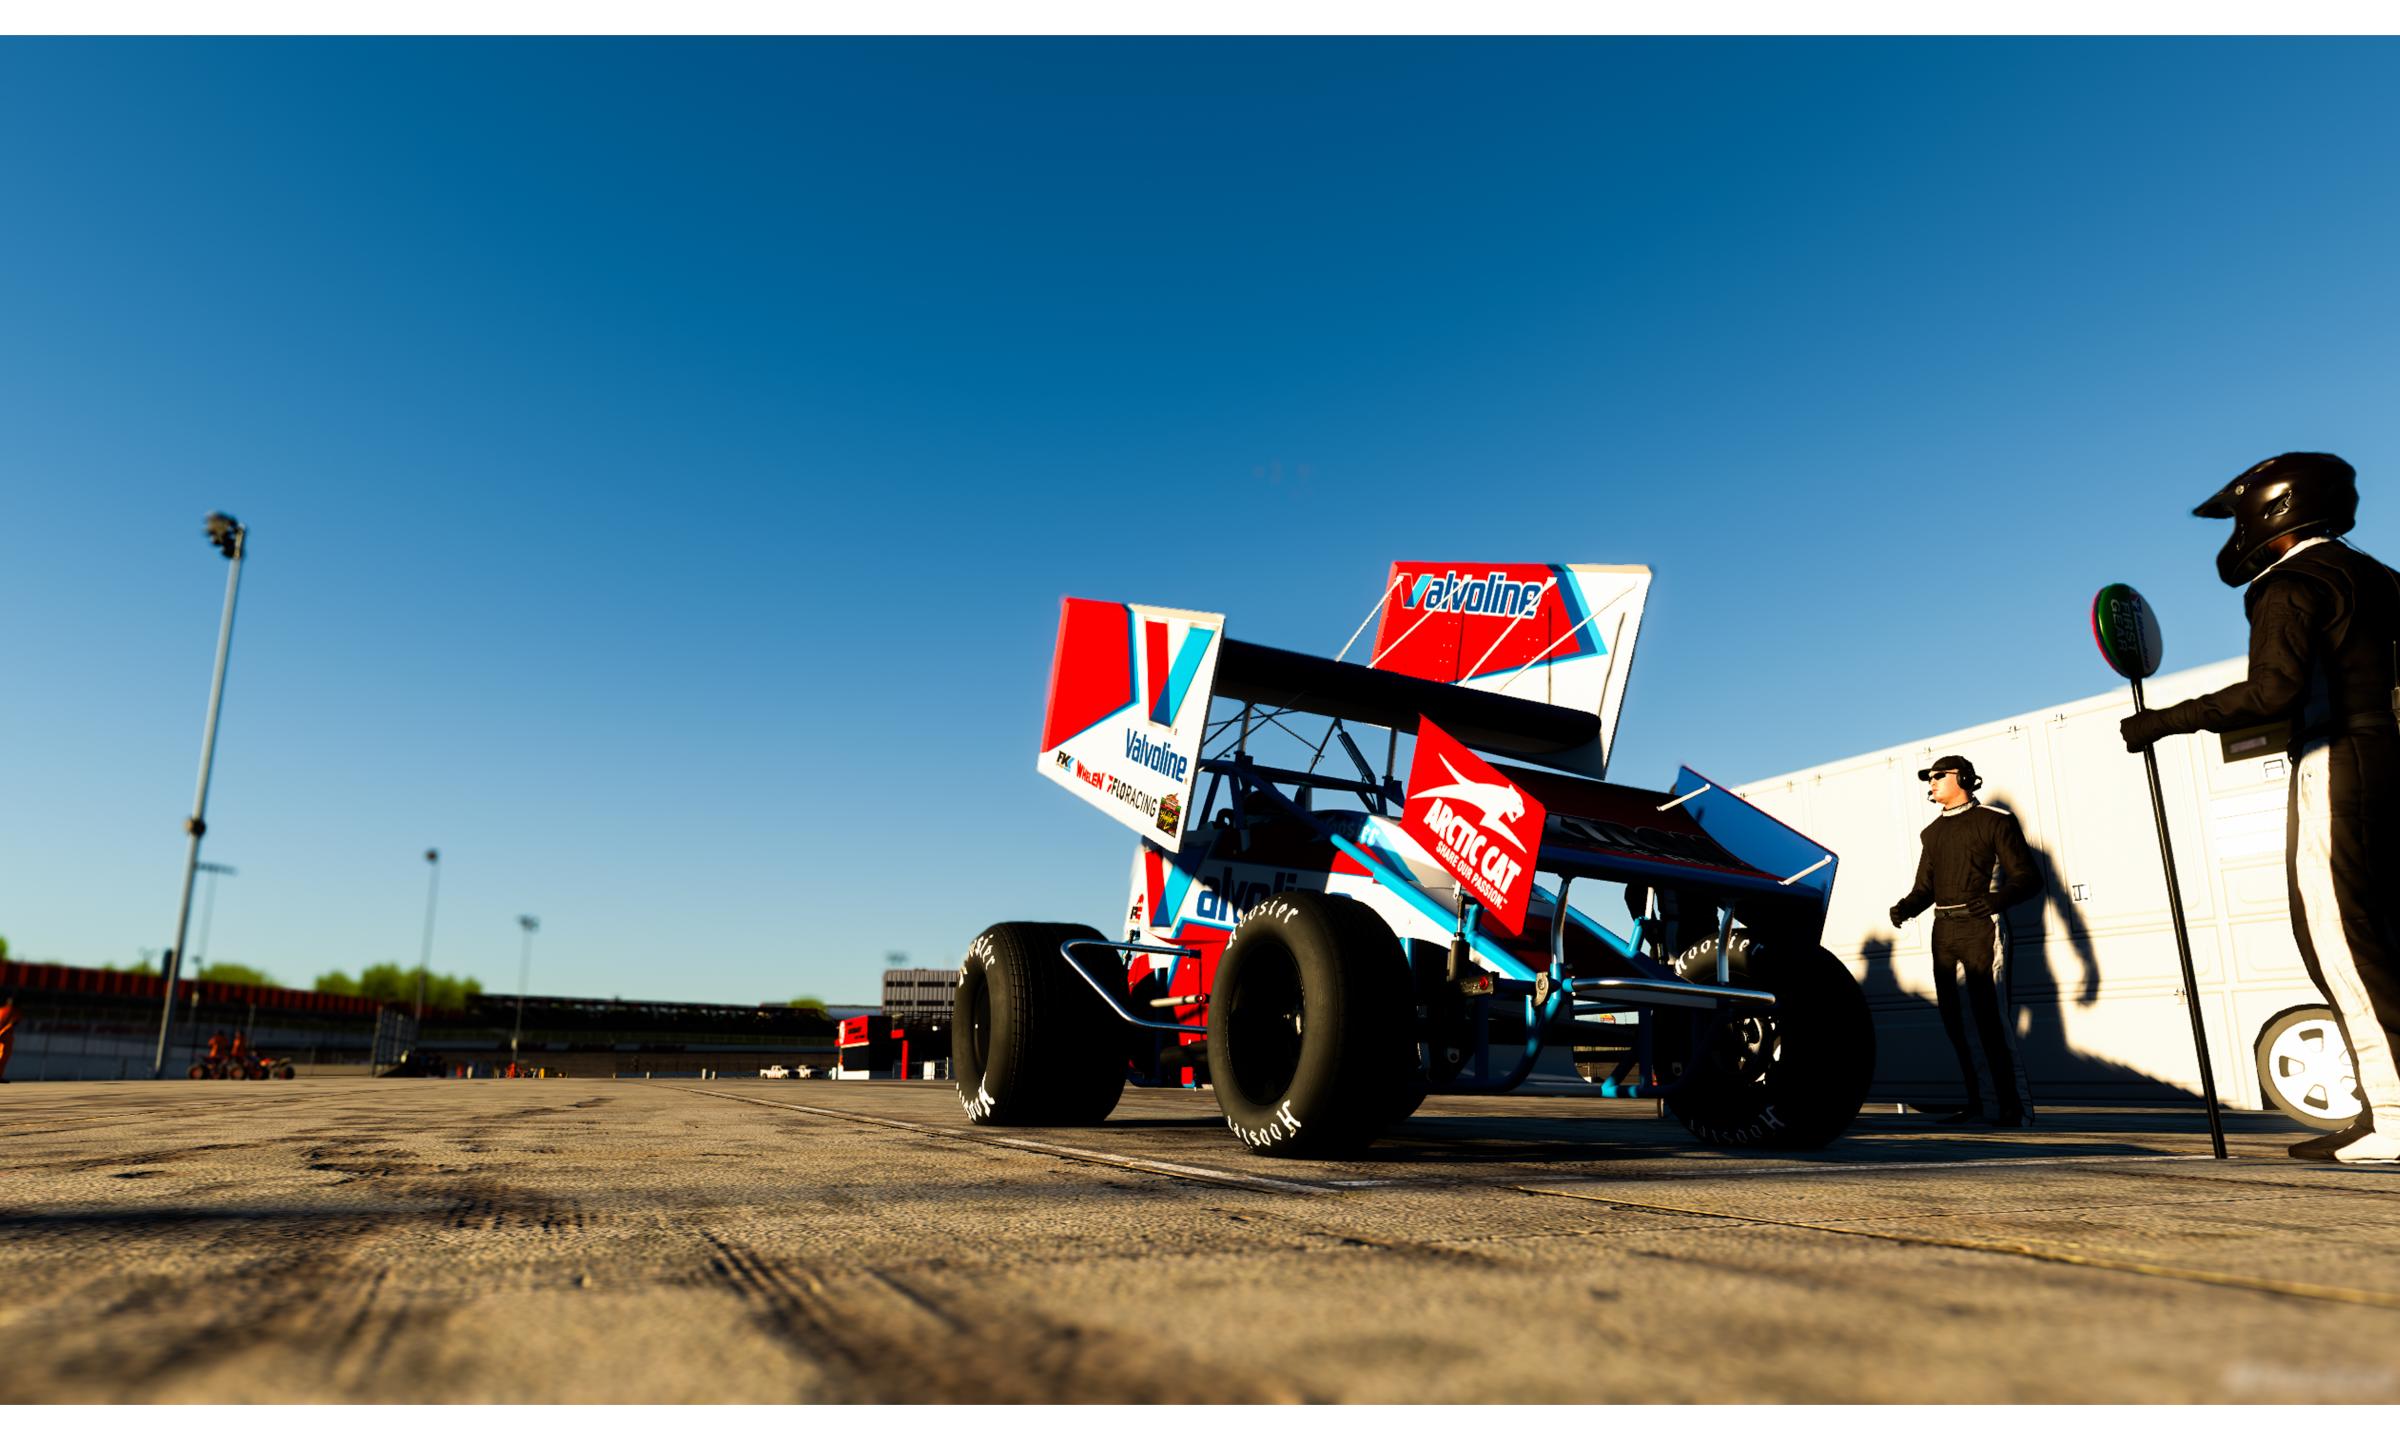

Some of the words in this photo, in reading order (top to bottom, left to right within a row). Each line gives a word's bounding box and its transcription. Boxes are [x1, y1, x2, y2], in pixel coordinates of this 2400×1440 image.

[1400, 571, 1542, 619] Valvoline
[2110, 598, 2128, 653] GEAR
[2120, 599, 2138, 655] FIRST
[1125, 728, 1188, 783] Valvoline
[1423, 798, 1488, 867] ARCTIC
[1481, 845, 1522, 894] CAT
[1436, 841, 1460, 869] SHARE
[1457, 861, 1474, 881] OUR
[1145, 847, 1353, 928] Valvoli
